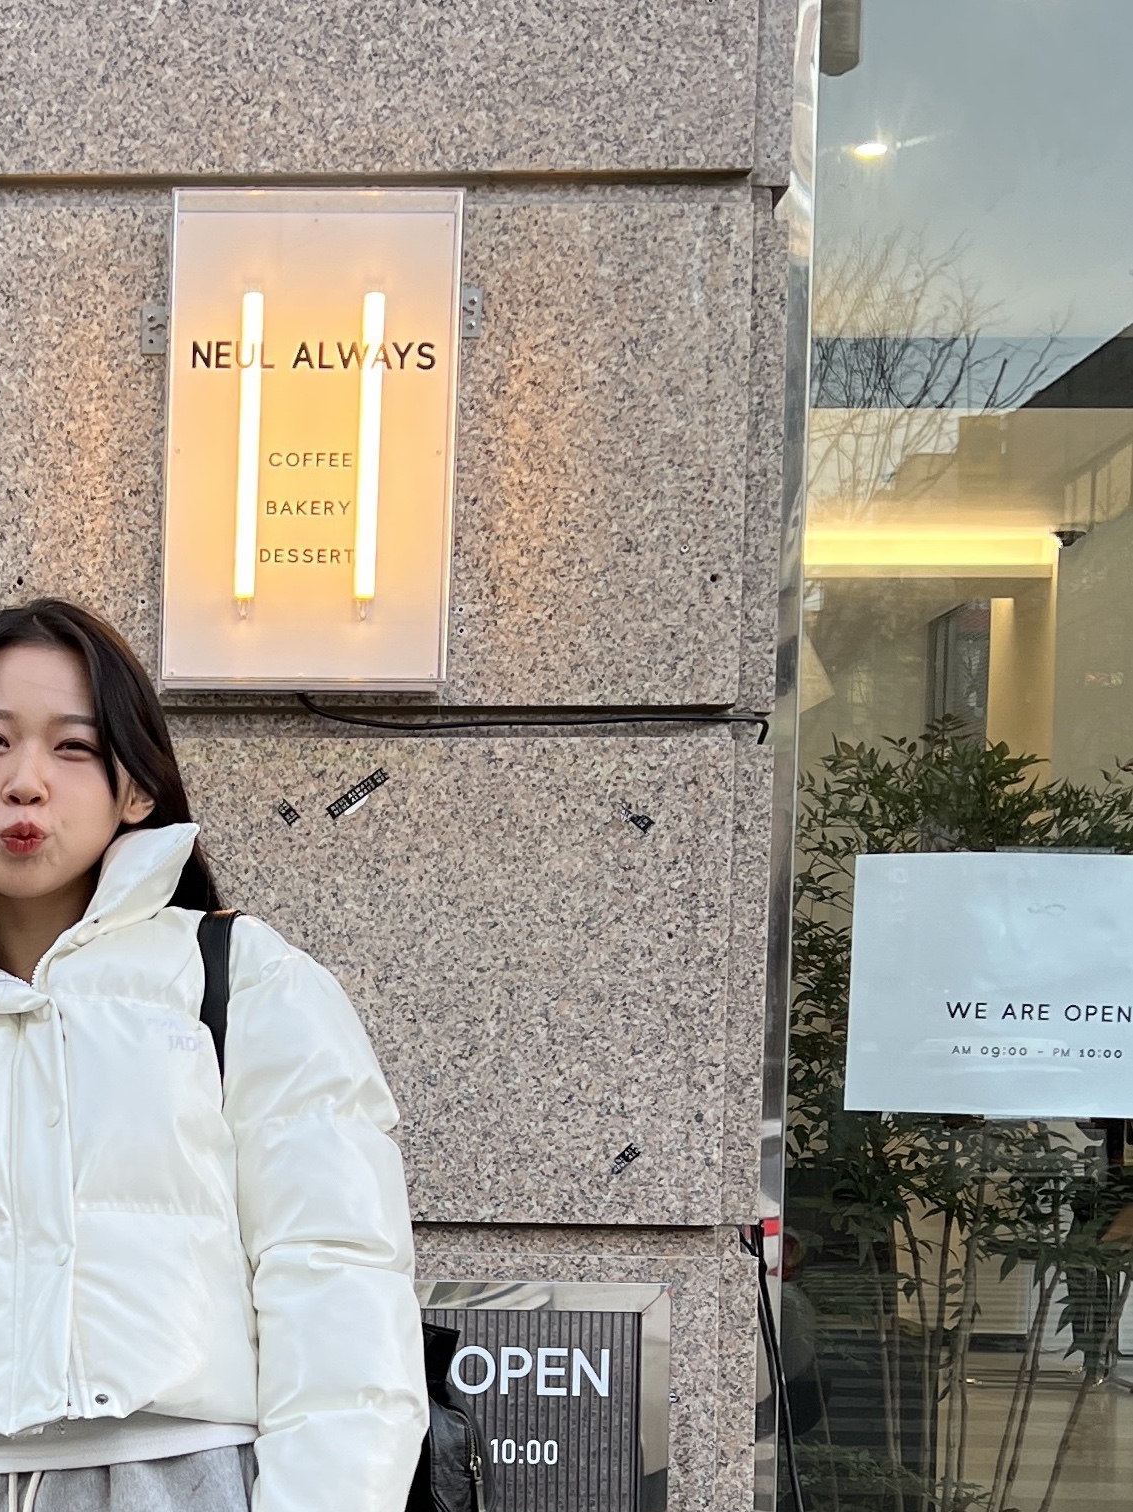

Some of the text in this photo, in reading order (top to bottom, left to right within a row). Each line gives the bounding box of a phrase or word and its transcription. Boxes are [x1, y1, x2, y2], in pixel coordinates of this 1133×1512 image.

[192, 340, 438, 370] NEUL ALWAYS
[268, 452, 353, 468] COFFEE
[265, 500, 351, 515] BAKERY
[259, 548, 356, 564] DESSERT
[946, 1001, 1133, 1023] WE ARE OPEN
[951, 1045, 971, 1055] AM
[980, 1045, 1028, 1058] 09:00
[1052, 1048, 1071, 1057] PM
[1079, 1048, 1123, 1058] 10:00
[451, 1346, 610, 1397] OPEN
[490, 1438, 558, 1465] 10:00
